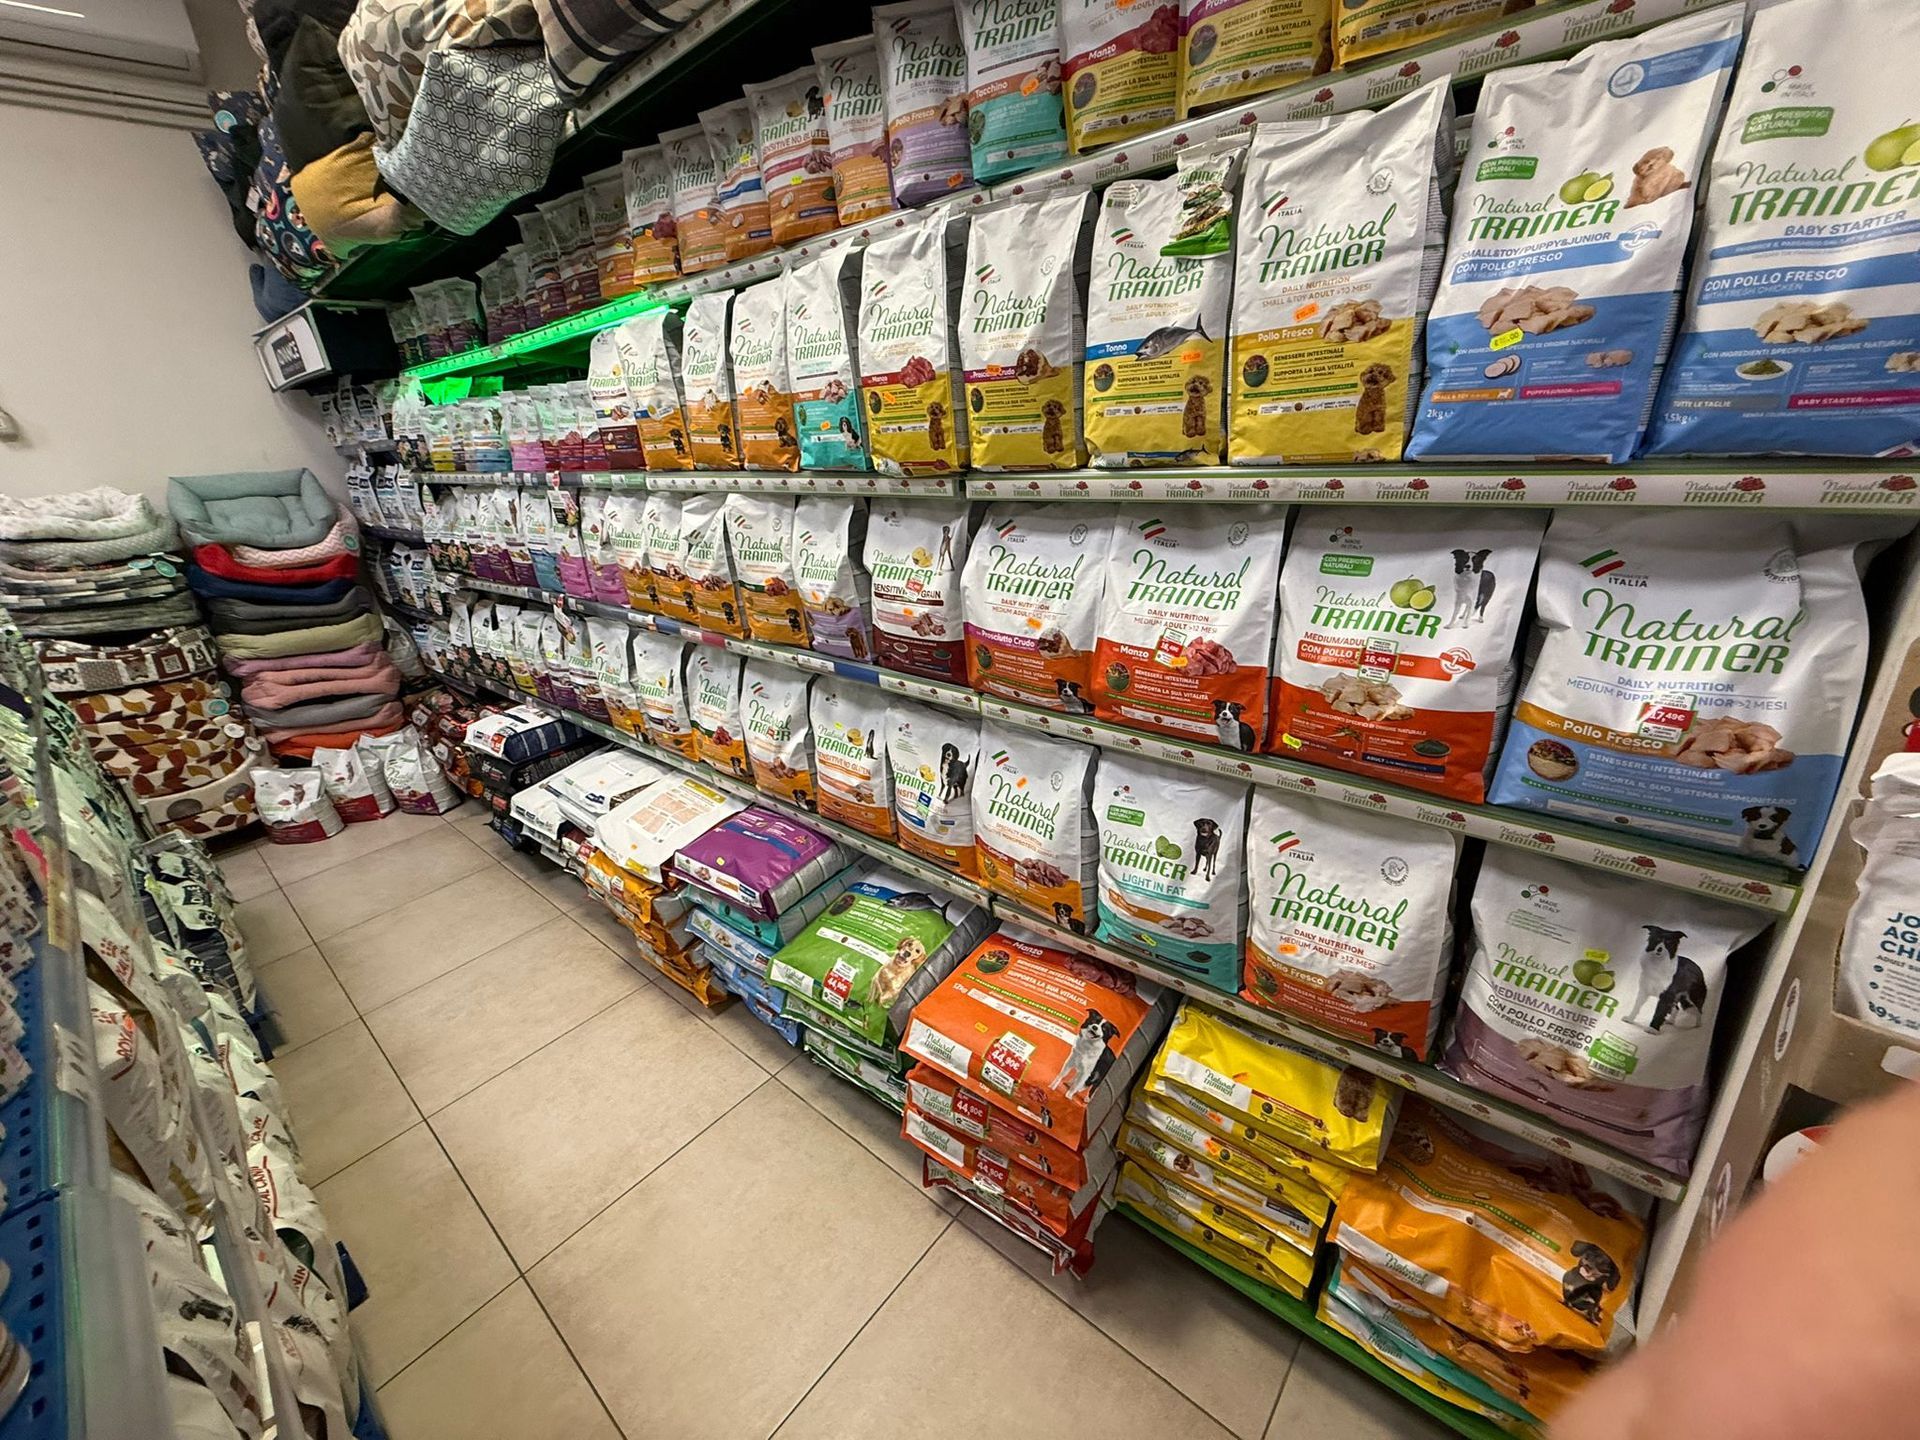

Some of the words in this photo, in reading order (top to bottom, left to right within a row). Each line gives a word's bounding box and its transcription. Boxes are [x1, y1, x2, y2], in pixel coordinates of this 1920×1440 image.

[1224, 12, 1256, 29] BENESSERE
[1257, 2, 1303, 20] INTESTINALE
[974, 10, 1058, 51] TRAINE
[1220, 31, 1253, 48] SUPPORTA
[1254, 29, 1263, 39] LA
[1264, 27, 1280, 37] SUA
[1281, 19, 1312, 33] VITALITÀ
[1088, 44, 1117, 60] Manzo
[895, 58, 965, 86] TRAINE
[975, 82, 1008, 99] Tacchino
[1100, 80, 1128, 93] SUPPORTA
[911, 109, 935, 122] Fresco
[1736, 156, 1857, 189] Natural
[1278, 208, 1303, 217] ITALIA
[1473, 194, 1555, 214] Natural
[1259, 202, 1398, 259] Natural
[1468, 199, 1620, 241] TRAINER
[1784, 225, 1827, 236] BABY
[1829, 209, 1907, 235] STARTER
[1259, 239, 1386, 283] TRAINER
[1456, 262, 1477, 274] CON
[1480, 257, 1516, 271] POLLO
[1517, 252, 1563, 266] FRESCO
[1108, 270, 1205, 302] TRAINER
[1282, 285, 1304, 294] DAILY
[1305, 276, 1350, 290] NUTRITION
[1704, 279, 1730, 292] CON
[1733, 272, 1781, 287] POLLO
[1784, 267, 1849, 282] FRESCO
[973, 278, 1053, 317] Natural
[1308, 290, 1335, 299] ADULT
[869, 295, 937, 327] Natural
[972, 306, 1047, 334] TRAINER
[794, 324, 841, 345] Natural
[871, 320, 934, 343] TRAINER
[1258, 331, 1280, 343] Pollo
[1281, 326, 1314, 339] Fresco
[794, 342, 842, 360] TRAINER
[1105, 343, 1128, 353] Tonno
[1273, 352, 1306, 362] BENESSERE
[1307, 347, 1345, 358] INTESTINALE
[1273, 368, 1303, 377] SUPPORTA
[1313, 365, 1326, 373] SUA
[1227, 490, 1270, 499] TRAINER
[1297, 490, 1345, 499] TRAINER
[1376, 490, 1429, 500] TRAINER
[1464, 490, 1526, 501] TRAINER
[1566, 490, 1637, 501] TRAINER
[1683, 491, 1765, 504] TRAINER
[1820, 490, 1916, 505] TRAINER
[735, 531, 783, 552] Natural
[1153, 539, 1178, 549] ITALIA
[738, 549, 784, 563] TRAINER
[800, 548, 841, 569] Natural
[989, 544, 1085, 581] Natural
[1322, 562, 1354, 571] NATURALI
[1323, 555, 1338, 564] CON
[801, 567, 838, 582] TRAINER
[1132, 548, 1252, 589] Natural
[986, 572, 1075, 601] TRAINER
[1607, 576, 1648, 589] ITALIA
[1127, 581, 1241, 611] TRAINER
[1316, 585, 1387, 608] Natural
[1147, 608, 1169, 618] DAILY
[1169, 611, 1210, 623] NUTRITION
[1163, 620, 1188, 631] ADULT
[1310, 604, 1443, 640] TRAINER
[1582, 587, 1804, 643] Natural
[981, 630, 1013, 645] Prosciutto
[1013, 637, 1035, 648] Crudo
[1303, 631, 1366, 648] MEDIUM/ADUL
[1120, 644, 1149, 658] Manzo
[1300, 643, 1322, 655] CON
[1322, 647, 1354, 658] POLLO
[1583, 631, 1791, 675] TRAINER
[1134, 669, 1164, 681] BENESSERE
[1164, 674, 1200, 685] INTESTINALE
[1617, 676, 1654, 690] DAILY
[1656, 679, 1735, 693] NUTRITION
[1134, 683, 1162, 694] SUPPORTA
[1183, 691, 1209, 701] VITALITÀ
[1566, 677, 1615, 698] MEDIUM
[1752, 700, 1788, 712] MESI
[1545, 719, 1561, 729] con
[1562, 719, 1603, 740] Pollo
[1605, 731, 1664, 750] Fresco
[1588, 752, 1648, 771] BENESSERE
[1650, 764, 1722, 781] INTESTINALE
[1584, 771, 1636, 788] SUPPORTA
[1638, 779, 1647, 789] IL
[1648, 781, 1672, 794] SUO
[1673, 784, 1720, 800] SISTEMA
[989, 774, 1061, 825] Natural
[987, 799, 1056, 841] TRAINER
[1103, 829, 1153, 854] Natural
[1103, 845, 1188, 882] TRAINER
[1288, 851, 1315, 863] ITALIA
[1122, 873, 1152, 889] LIGHT
[1153, 881, 1165, 892] IN
[1166, 884, 1187, 896] FAT
[1269, 861, 1409, 930] Natural
[1269, 896, 1400, 951] TRAINER
[1013, 941, 1044, 957] Manzo
[1279, 935, 1311, 951] MEDIUM
[1312, 944, 1339, 959] ADULT
[1354, 956, 1376, 970] MESI
[1294, 928, 1317, 941] DAILY
[1318, 934, 1365, 956] NUTRITION
[1266, 955, 1289, 975] Pollo
[1290, 966, 1324, 986] Fresco
[1496, 942, 1569, 979] Natural
[1046, 983, 1060, 994] SUA
[1059, 988, 1088, 1007] VITALITÀ
[1490, 959, 1621, 1019] TRAINER
[1282, 993, 1315, 1009] SUPPORTA
[1491, 981, 1598, 1029] MEDIUM/MATURE
[1487, 994, 1506, 1013] CON
[1506, 1004, 1546, 1028] POLLO
[1546, 1020, 1594, 1045] FRESCO
[1500, 1011, 1527, 1031] FRESH
[1527, 1022, 1564, 1044] CHICKEN
[1564, 1036, 1582, 1049] AND
[991, 1050, 1020, 1071] 44,90€
[1204, 1069, 1236, 1090] Natural
[956, 1100, 984, 1118] 44,90€
[977, 1161, 1004, 1181] 44,90€
